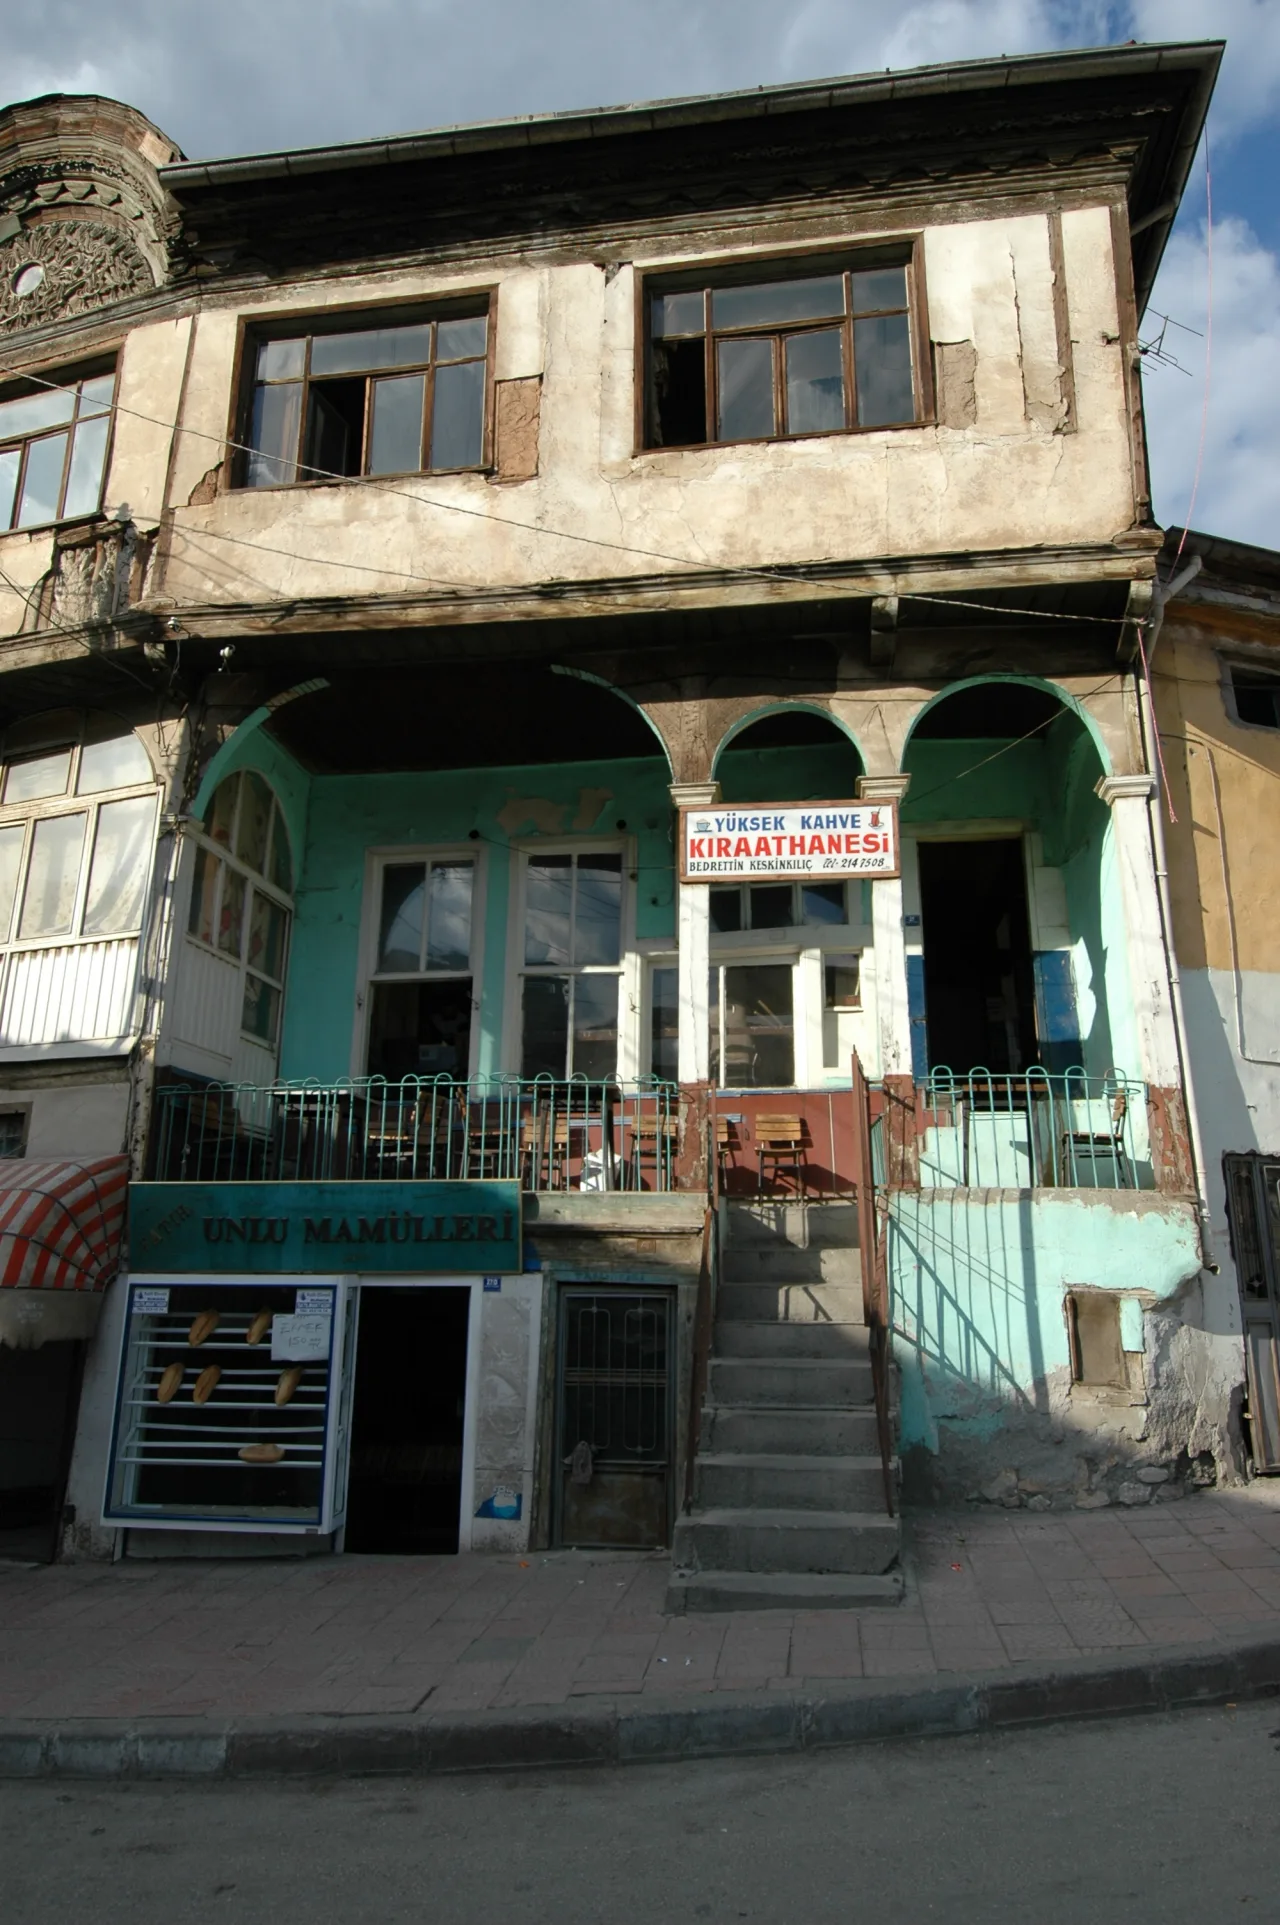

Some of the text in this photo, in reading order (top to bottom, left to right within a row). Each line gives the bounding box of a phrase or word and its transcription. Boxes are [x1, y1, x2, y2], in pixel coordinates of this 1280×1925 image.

[715, 812, 861, 832] YÜKSEK KAHVE
[690, 859, 743, 872] BEDRETTİN
[750, 858, 812, 872] KESKİNKILIÇ
[201, 1210, 514, 1243] UNLU MAMÜLLERİ
